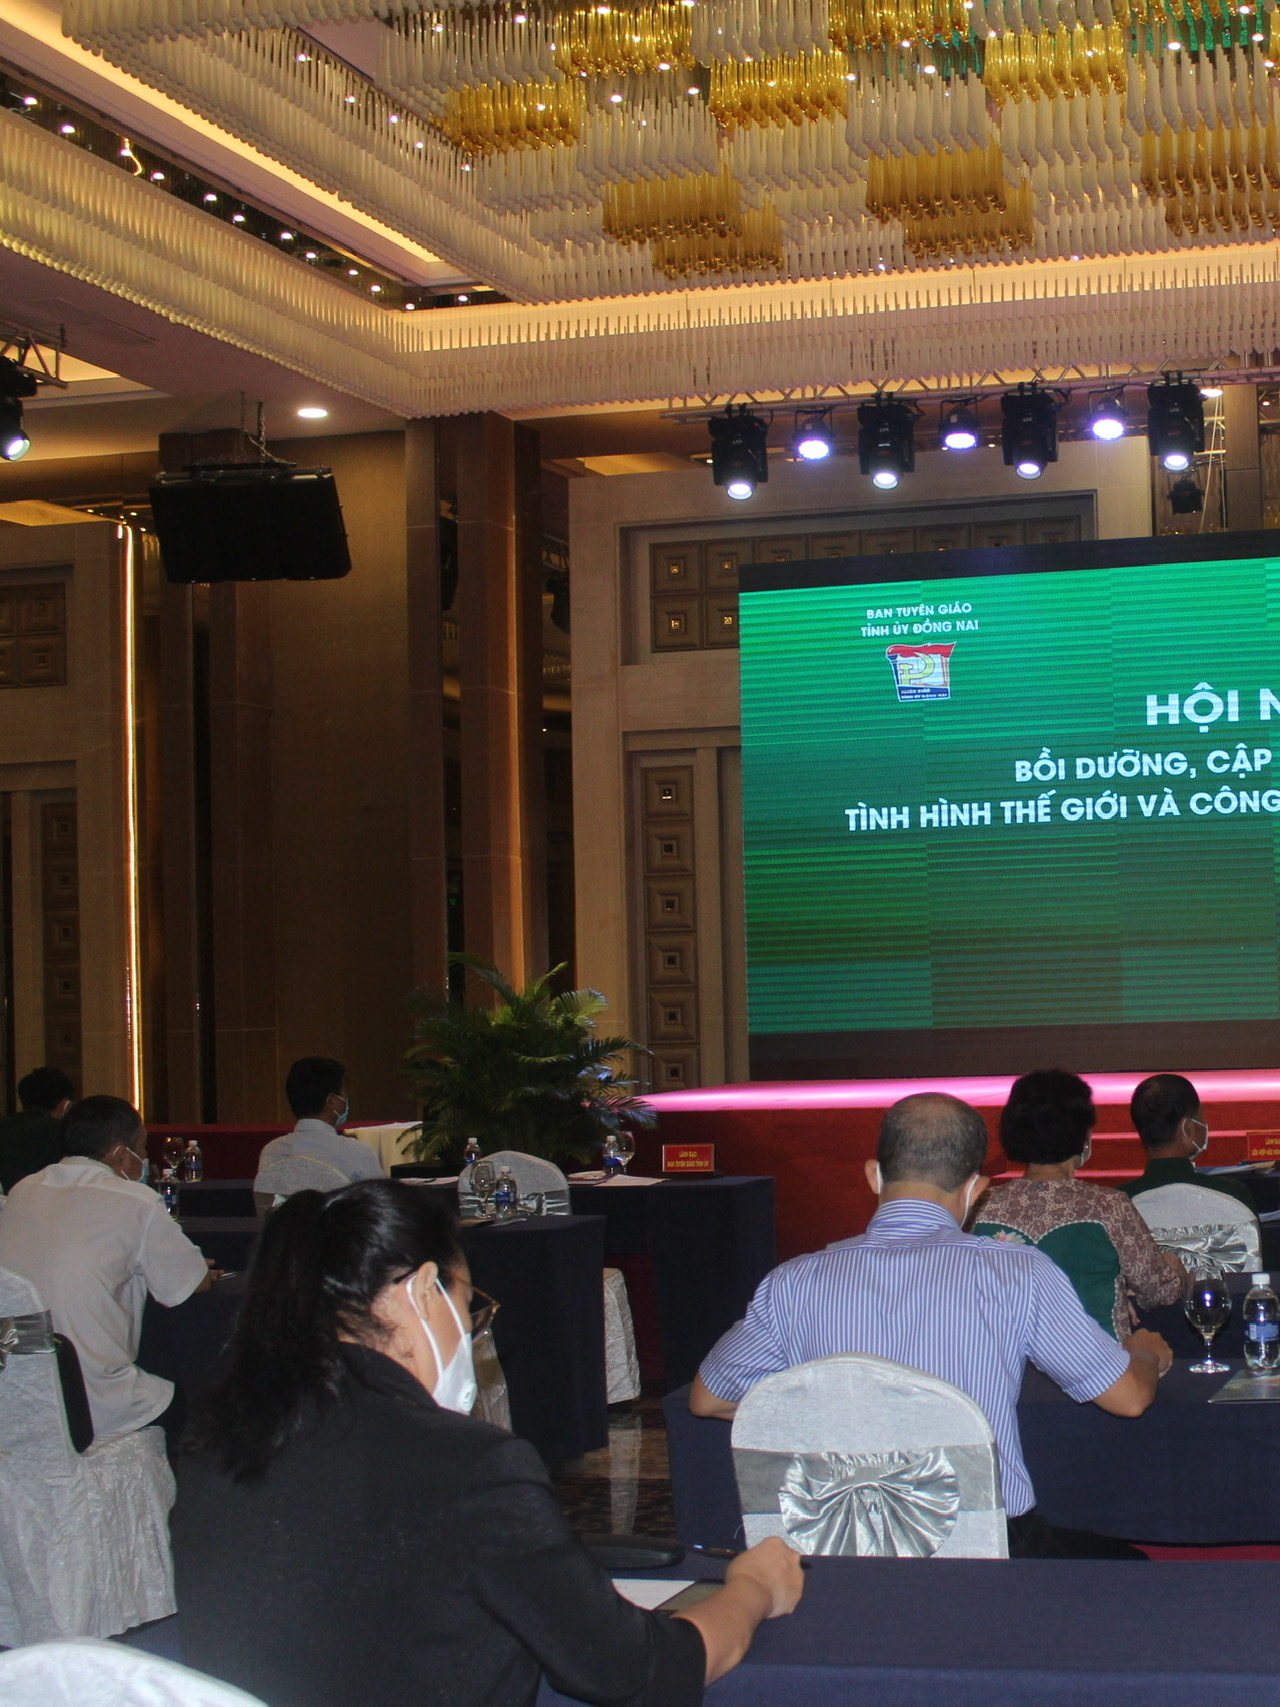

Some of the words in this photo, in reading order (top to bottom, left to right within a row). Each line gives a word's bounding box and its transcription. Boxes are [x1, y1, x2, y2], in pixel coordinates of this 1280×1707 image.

[861, 623, 889, 637] TỈNH
[893, 621, 909, 635] ỦY
[913, 618, 952, 633] ĐỒNG
[956, 619, 979, 631] NAI
[866, 608, 892, 619] BAN
[896, 604, 934, 617] TUYÊN
[938, 601, 972, 614] GIÁO
[1146, 682, 1239, 733] HỘI
[1015, 747, 1065, 782] BỒI
[1076, 749, 1197, 779] DƯỠNG,
[1207, 743, 1272, 779] CẬP
[845, 802, 909, 831] TÌNH
[920, 798, 991, 827] HÌNH
[1000, 789, 1056, 824] THẾ
[1060, 790, 1127, 821] GIỚI
[1137, 788, 1180, 816] VÀ
